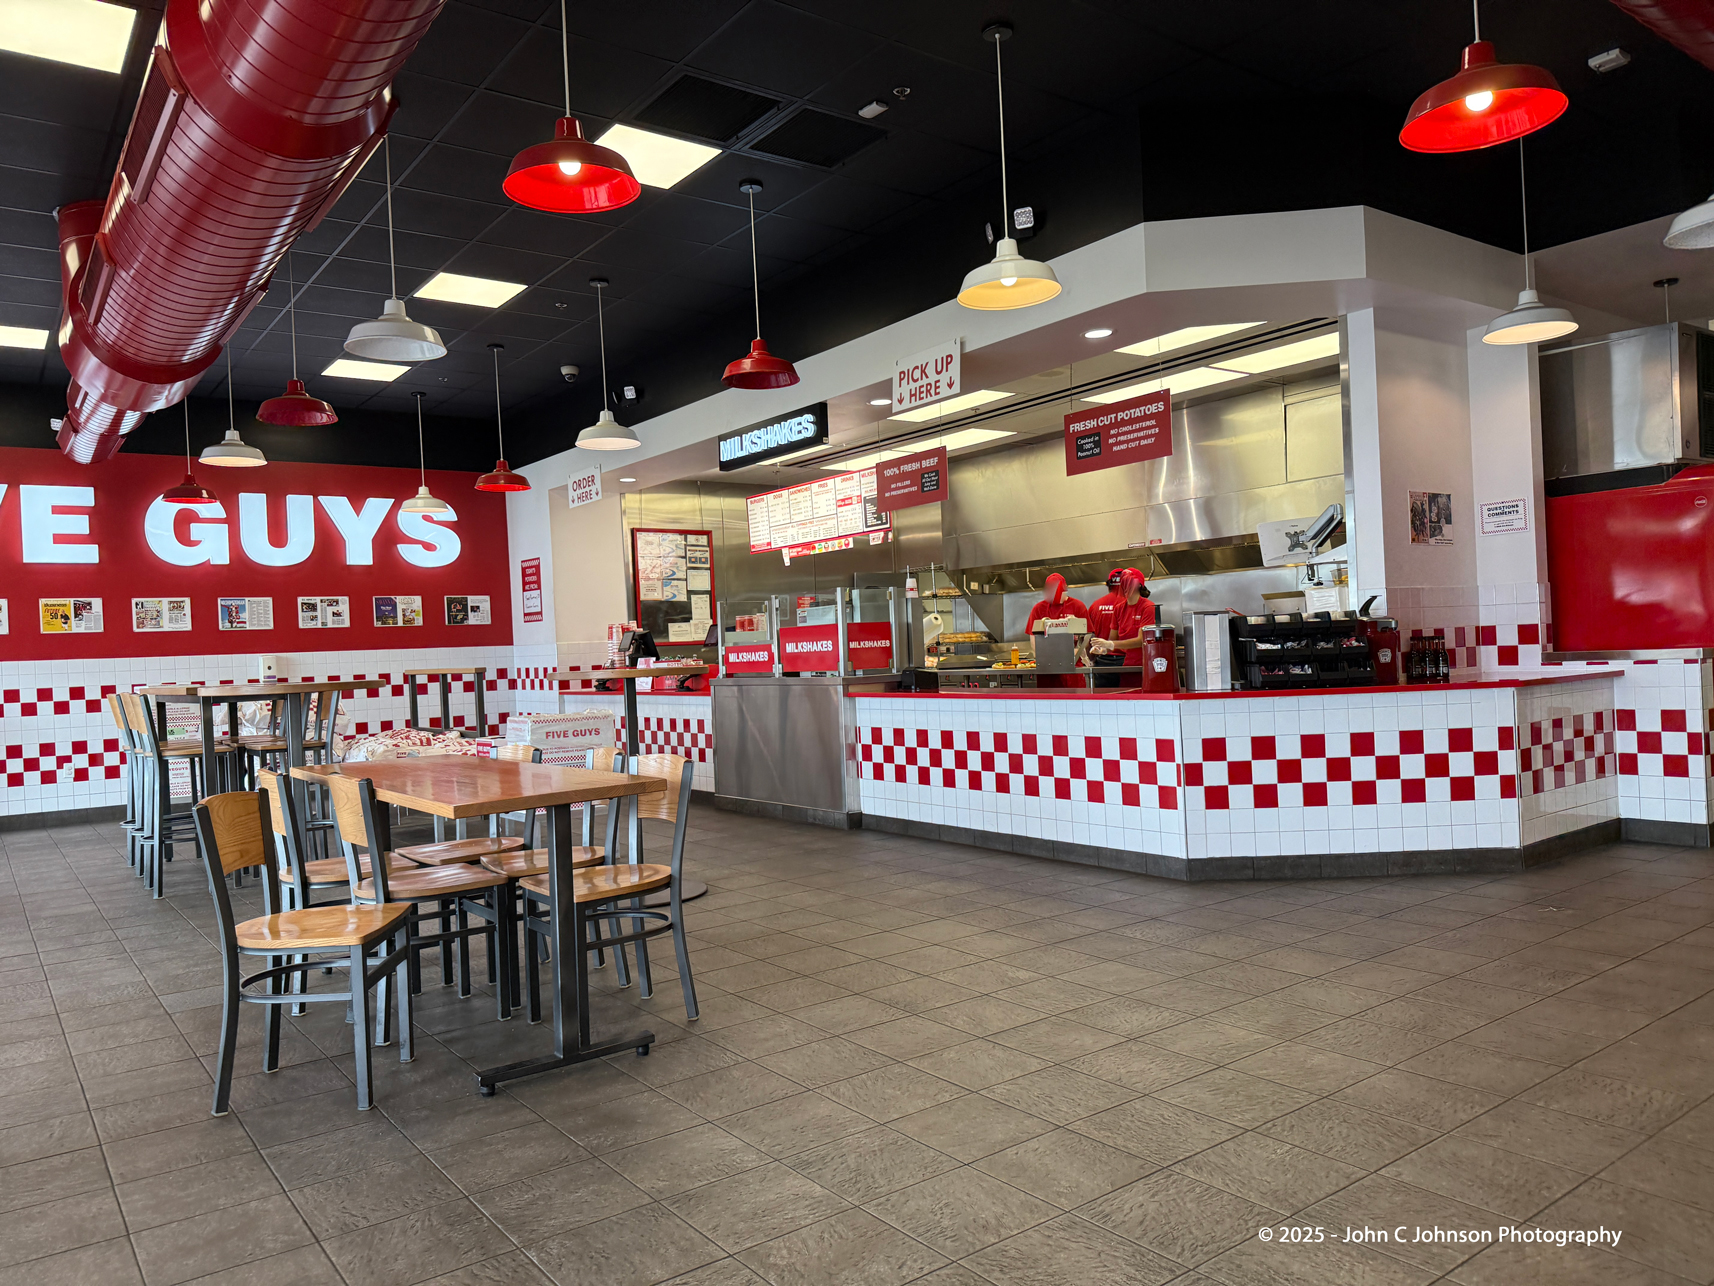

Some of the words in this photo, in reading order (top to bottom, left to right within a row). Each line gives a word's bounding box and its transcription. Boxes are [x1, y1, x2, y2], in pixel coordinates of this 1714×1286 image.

[898, 362, 929, 388] PICK
[934, 354, 954, 375] UP
[909, 379, 941, 404] HERE
[1070, 418, 1097, 434] FRESH
[1098, 414, 1116, 426] CUT
[1117, 402, 1164, 422] POTATOES
[1118, 419, 1156, 433] CHOLESTEROL
[720, 414, 816, 462] MILKSHAKES
[1117, 428, 1159, 442] PRESERVATIVES
[1112, 442, 1128, 452] HAND
[1140, 438, 1156, 446] DAILY
[884, 467, 899, 477] 100%
[900, 462, 920, 473] FRESH
[922, 457, 938, 468] BEEF
[572, 474, 596, 492] ORDER
[577, 490, 593, 504] HERE
[1487, 504, 1519, 512] QUESTIONS
[144, 492, 461, 568] GUYS
[786, 640, 833, 653] MILKSHAKES
[849, 640, 890, 649] MILKSHAKES
[729, 651, 768, 663] MILKSHAKES
[546, 730, 569, 740] FIVE
[572, 728, 601, 738] GUYS
